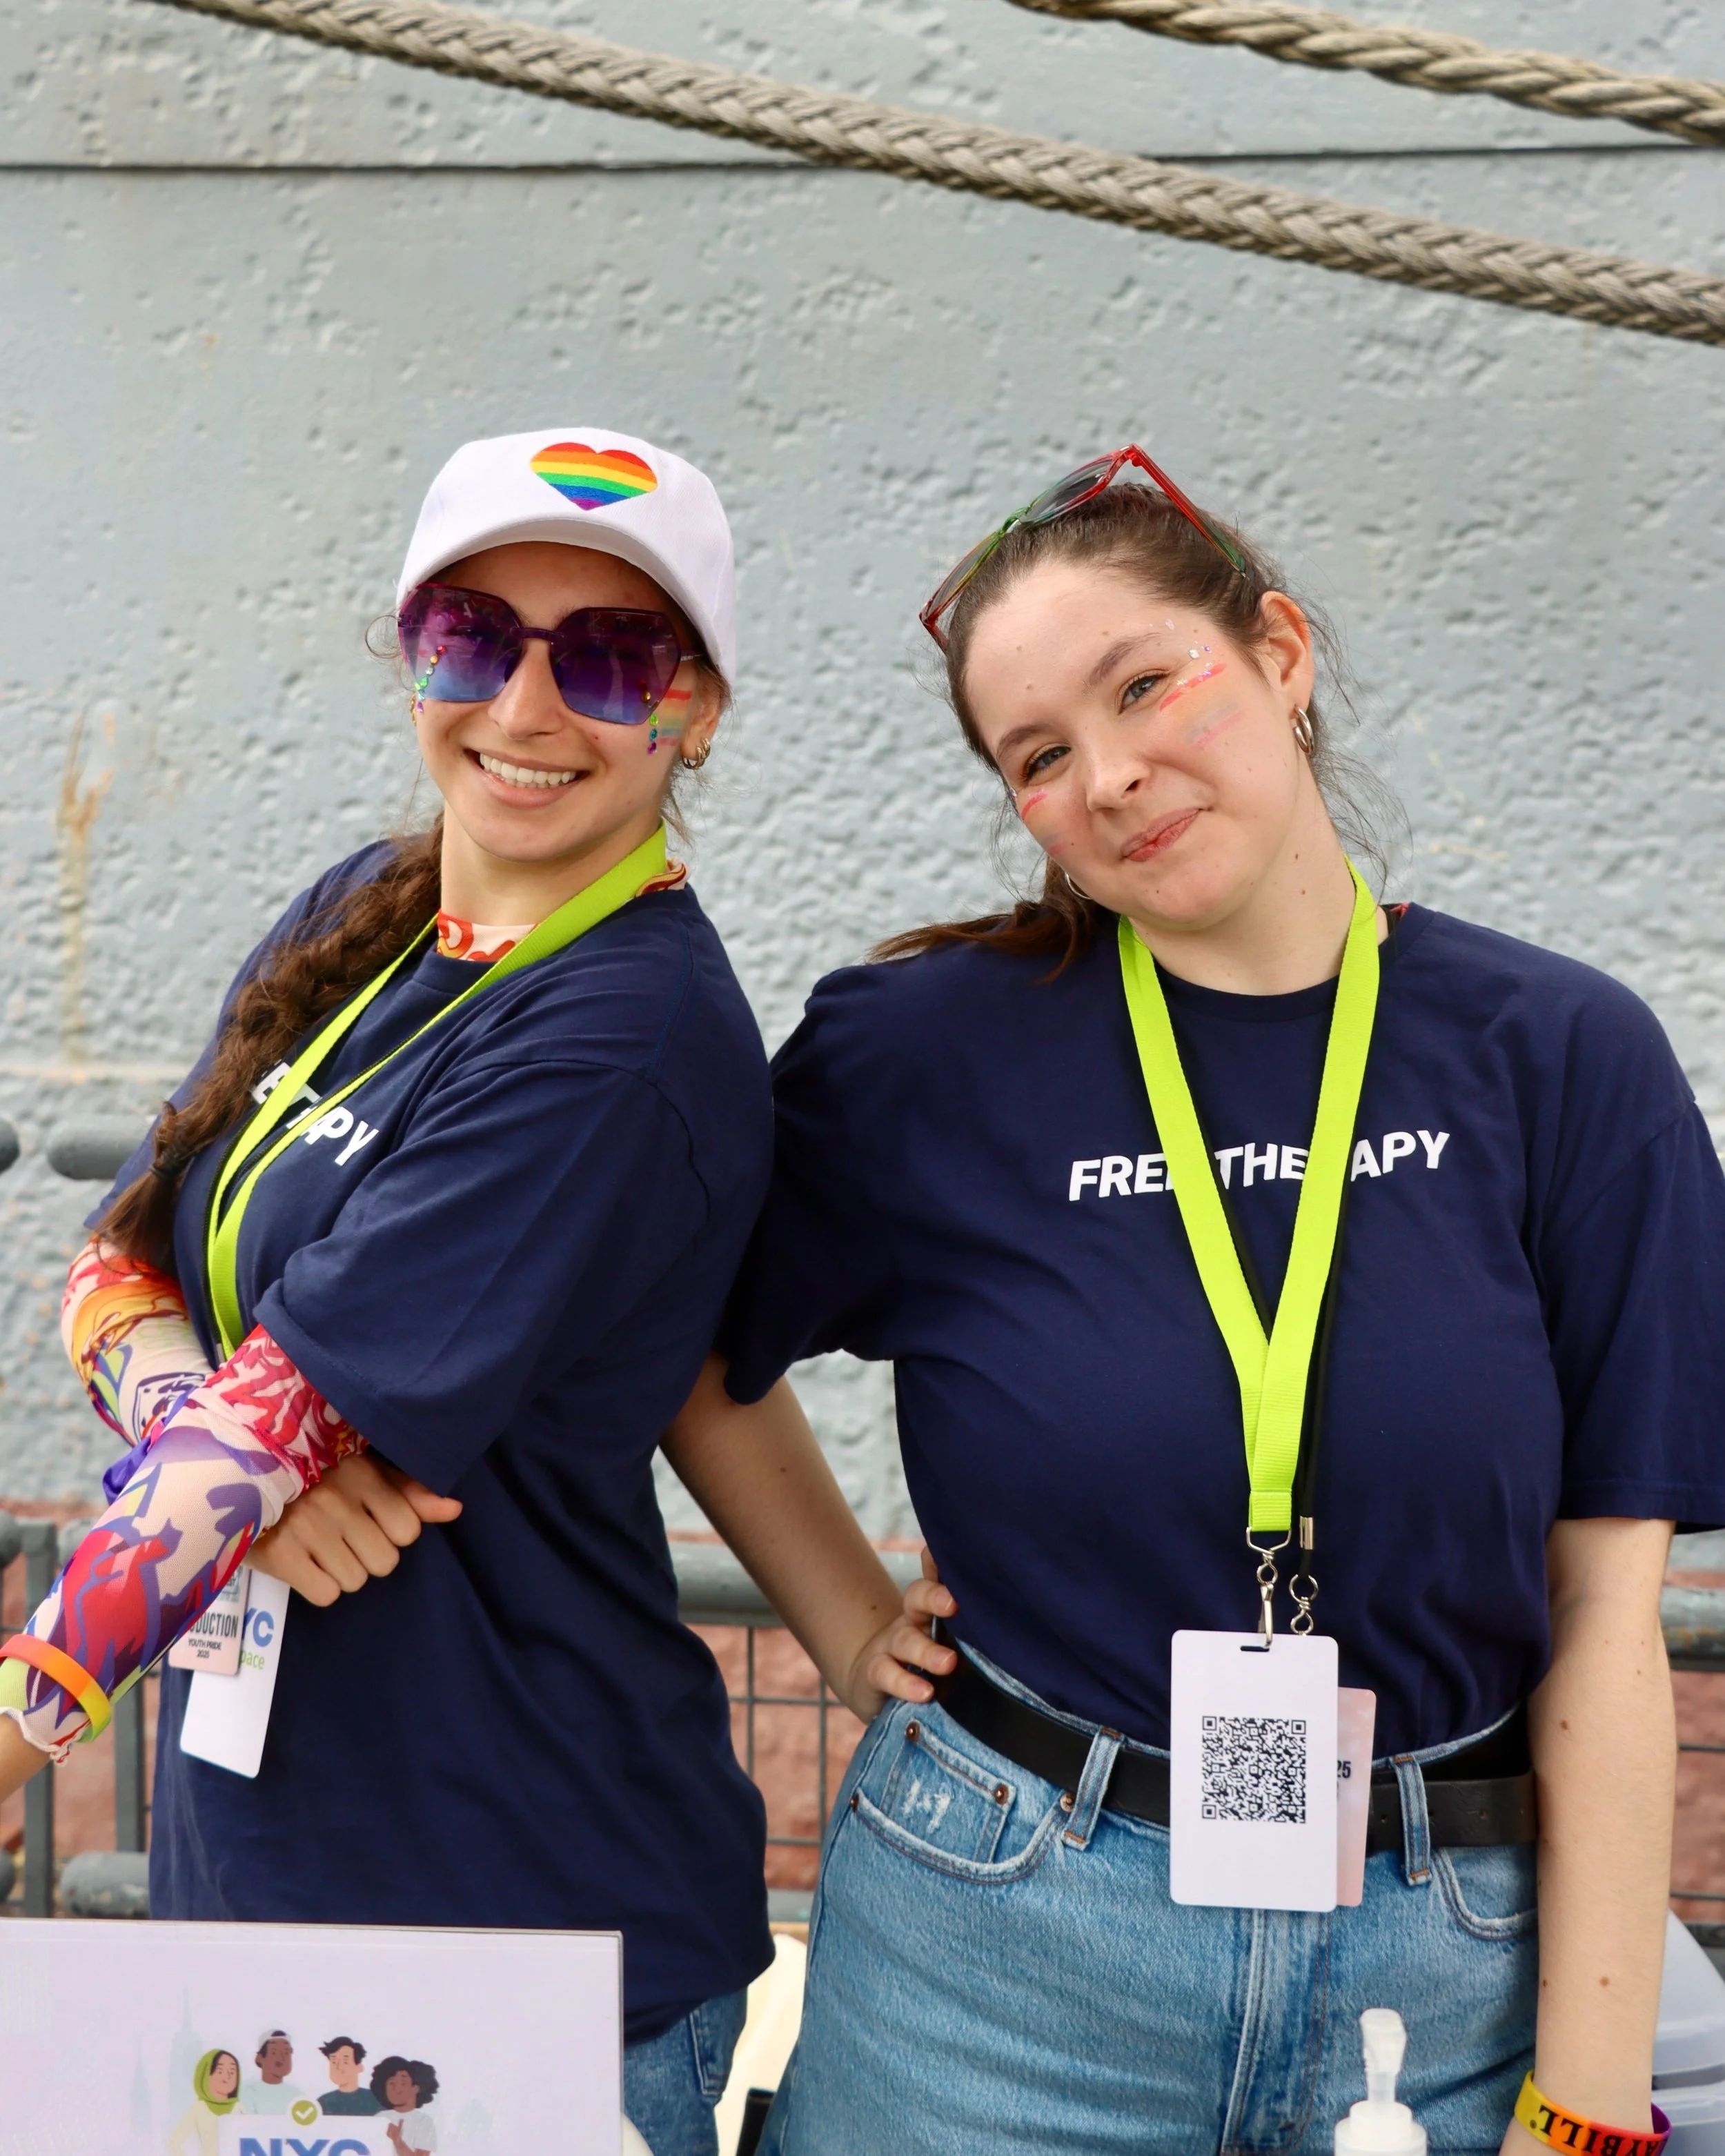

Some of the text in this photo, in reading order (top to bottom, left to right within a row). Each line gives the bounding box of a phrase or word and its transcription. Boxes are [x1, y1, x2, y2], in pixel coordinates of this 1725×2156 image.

[1069, 1129, 1450, 1202] FRE THEAPY
[190, 1612, 239, 1638] DUCTION
[188, 1638, 221, 1650] YOUTH PRIDE
[240, 1650, 265, 1670] pace
